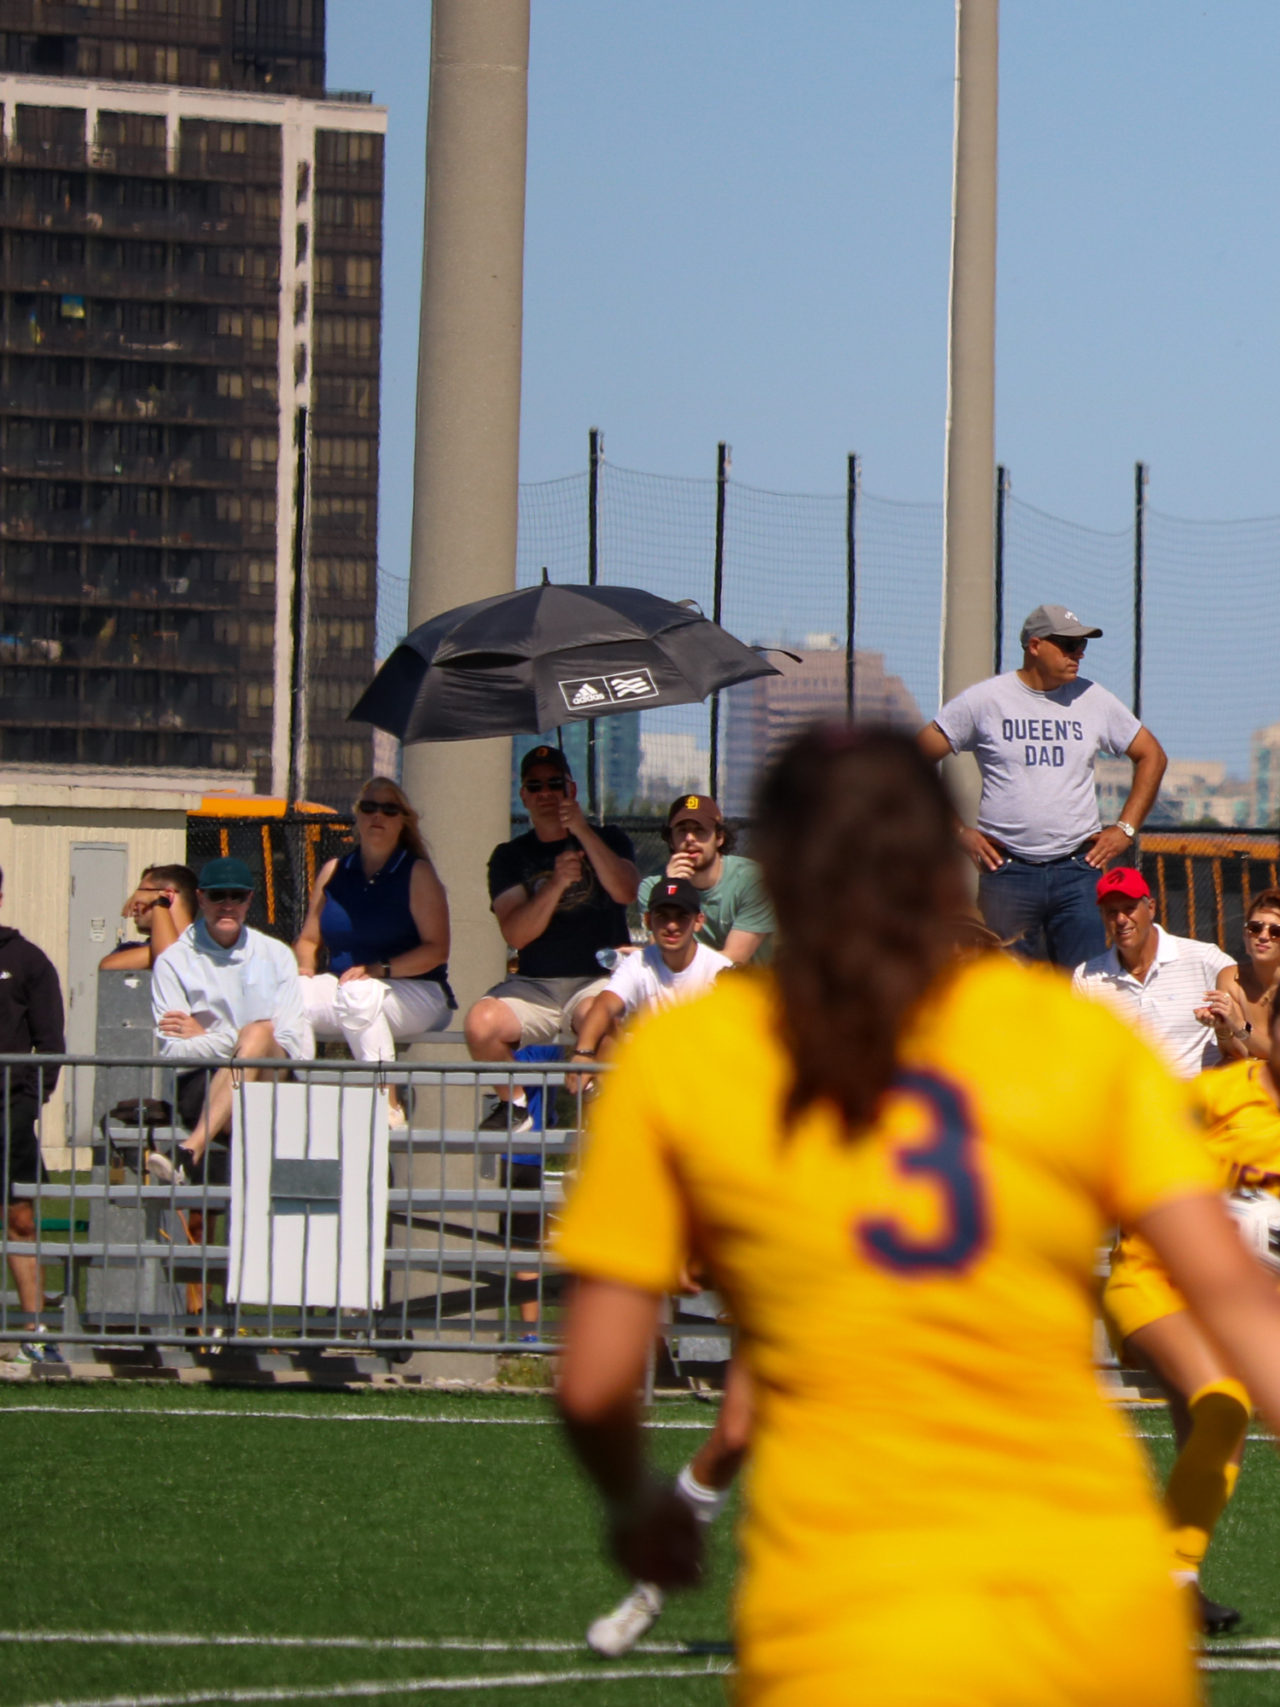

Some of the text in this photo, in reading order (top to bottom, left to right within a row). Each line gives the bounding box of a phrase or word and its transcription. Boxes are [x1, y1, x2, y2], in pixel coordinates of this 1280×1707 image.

[573, 693, 605, 705] adidas
[1002, 719, 1083, 741] QUEEN'S
[1025, 745, 1064, 767] DAD
[856, 1070, 990, 1278] 3
